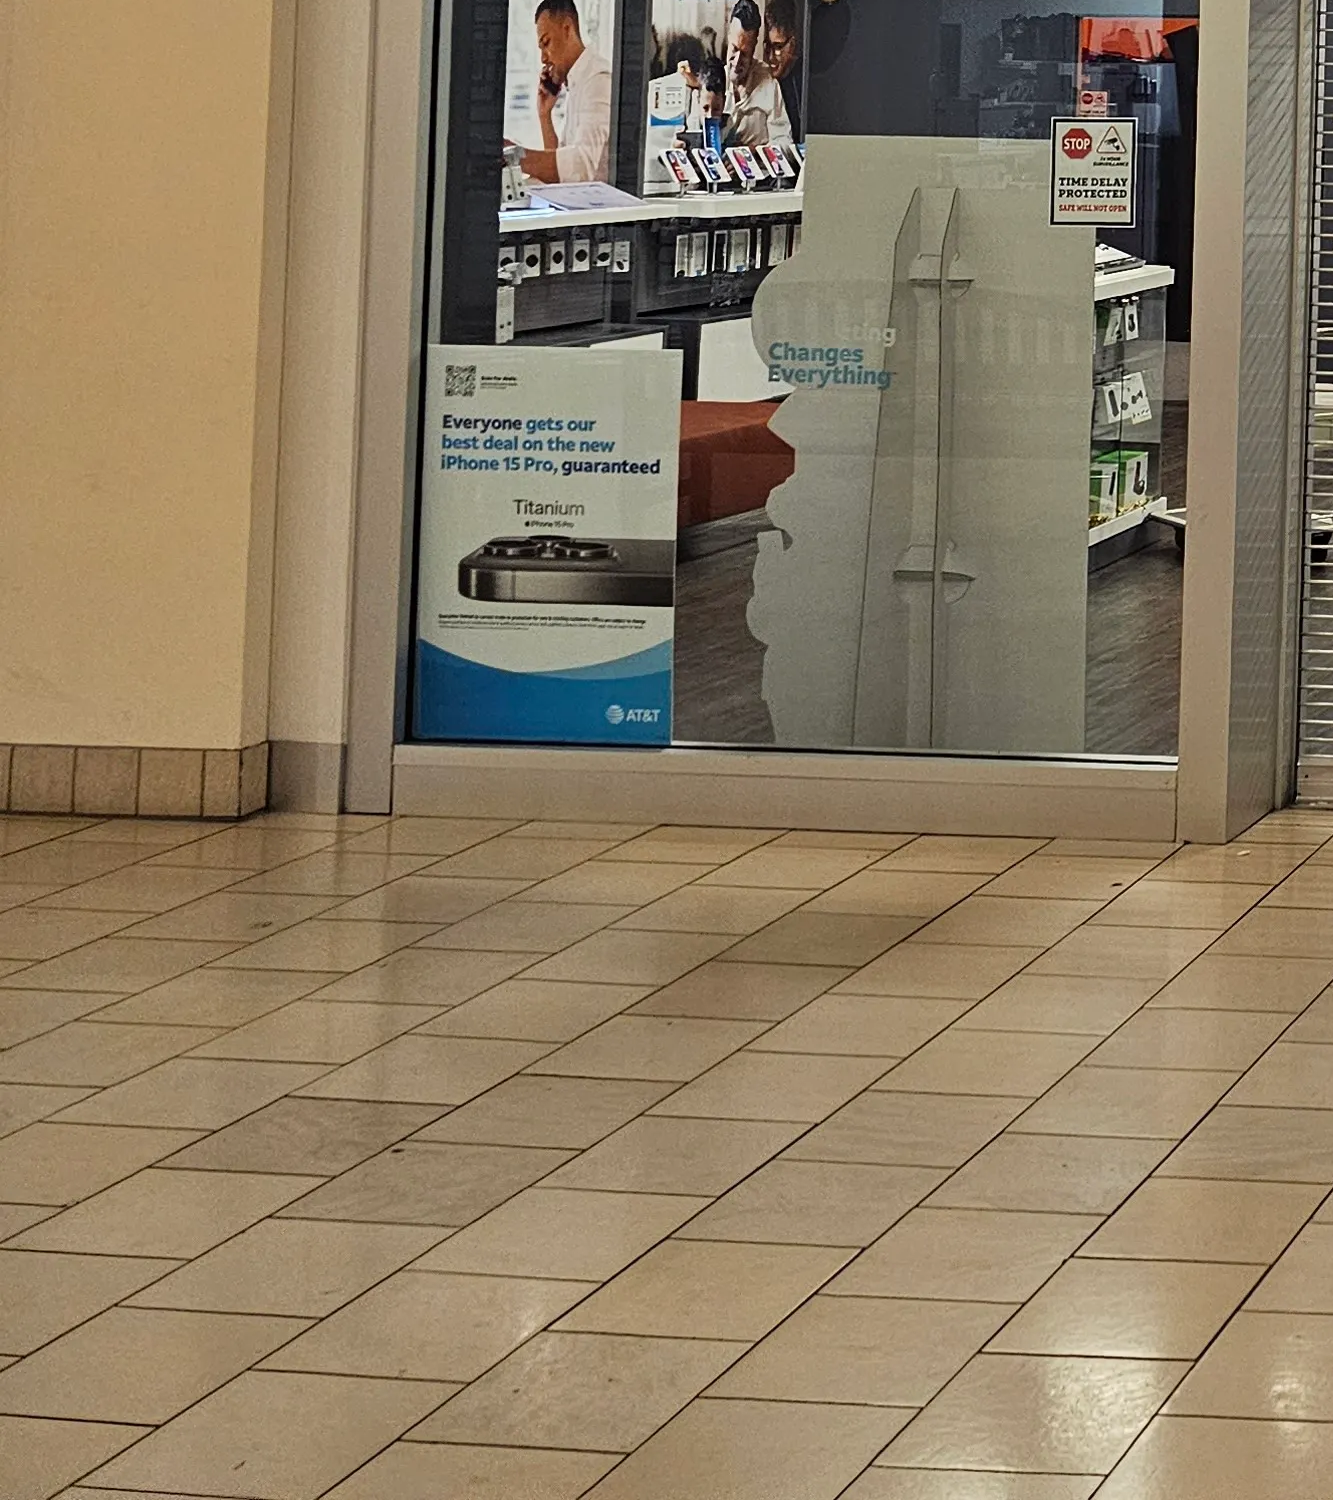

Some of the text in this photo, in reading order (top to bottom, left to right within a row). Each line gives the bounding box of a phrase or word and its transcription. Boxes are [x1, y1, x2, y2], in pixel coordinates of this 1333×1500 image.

[1063, 138, 1091, 150] STOP
[1059, 177, 1128, 187] TIME DELAY
[1058, 189, 1128, 199] PROTECTED
[768, 342, 864, 366] Changes
[768, 363, 893, 391] Everything
[442, 414, 597, 434] Everyone gets our
[442, 434, 615, 453] best deal on the new
[440, 454, 661, 476] iPhone 15 Pro, guaranteed
[512, 498, 585, 516] Titanium
[626, 708, 661, 723] AT&T
